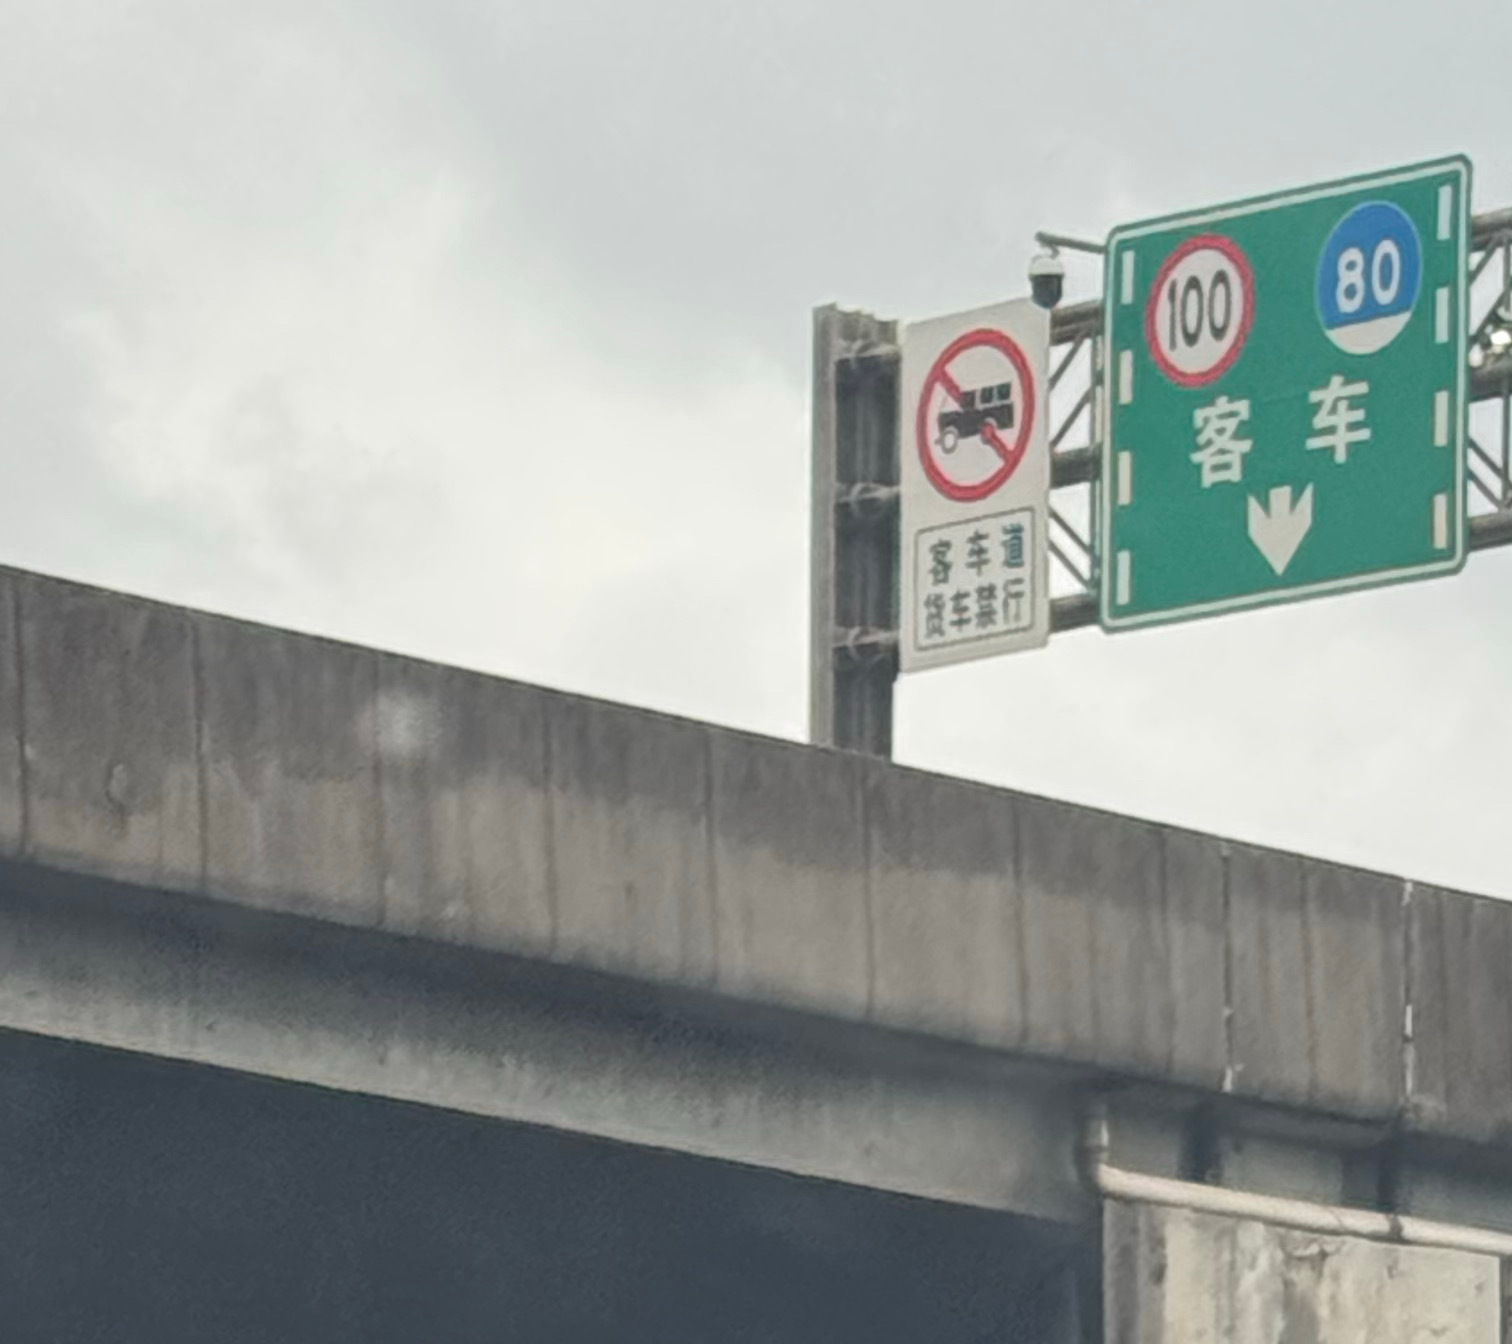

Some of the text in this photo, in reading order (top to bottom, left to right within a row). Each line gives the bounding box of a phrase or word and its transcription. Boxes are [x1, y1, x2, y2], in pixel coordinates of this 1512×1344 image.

[1166, 269, 1232, 353] 100
[1335, 238, 1401, 314] 80
[1190, 374, 1372, 488] 客车
